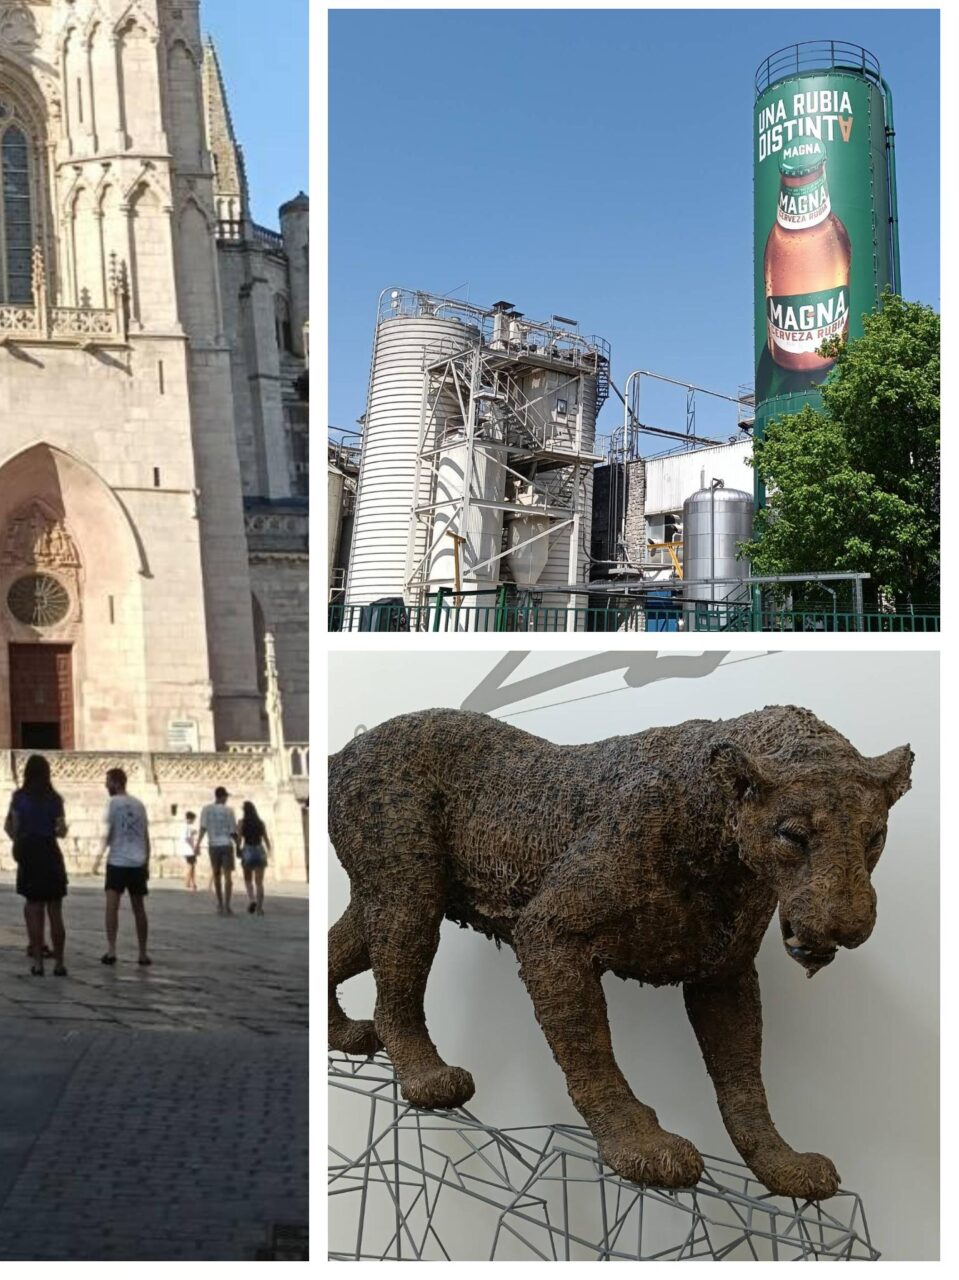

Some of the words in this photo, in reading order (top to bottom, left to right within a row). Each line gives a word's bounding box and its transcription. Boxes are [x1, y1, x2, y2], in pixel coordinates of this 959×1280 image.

[758, 99, 787, 134] UNA
[793, 90, 853, 117] RUBIA
[783, 143, 821, 160] MAGNA
[779, 186, 829, 214] MAGNA
[778, 210, 806, 223] CERVEZA
[770, 290, 846, 331] MAGNA
[770, 323, 813, 342] CERVEZA
[817, 316, 846, 338] RUBIA
